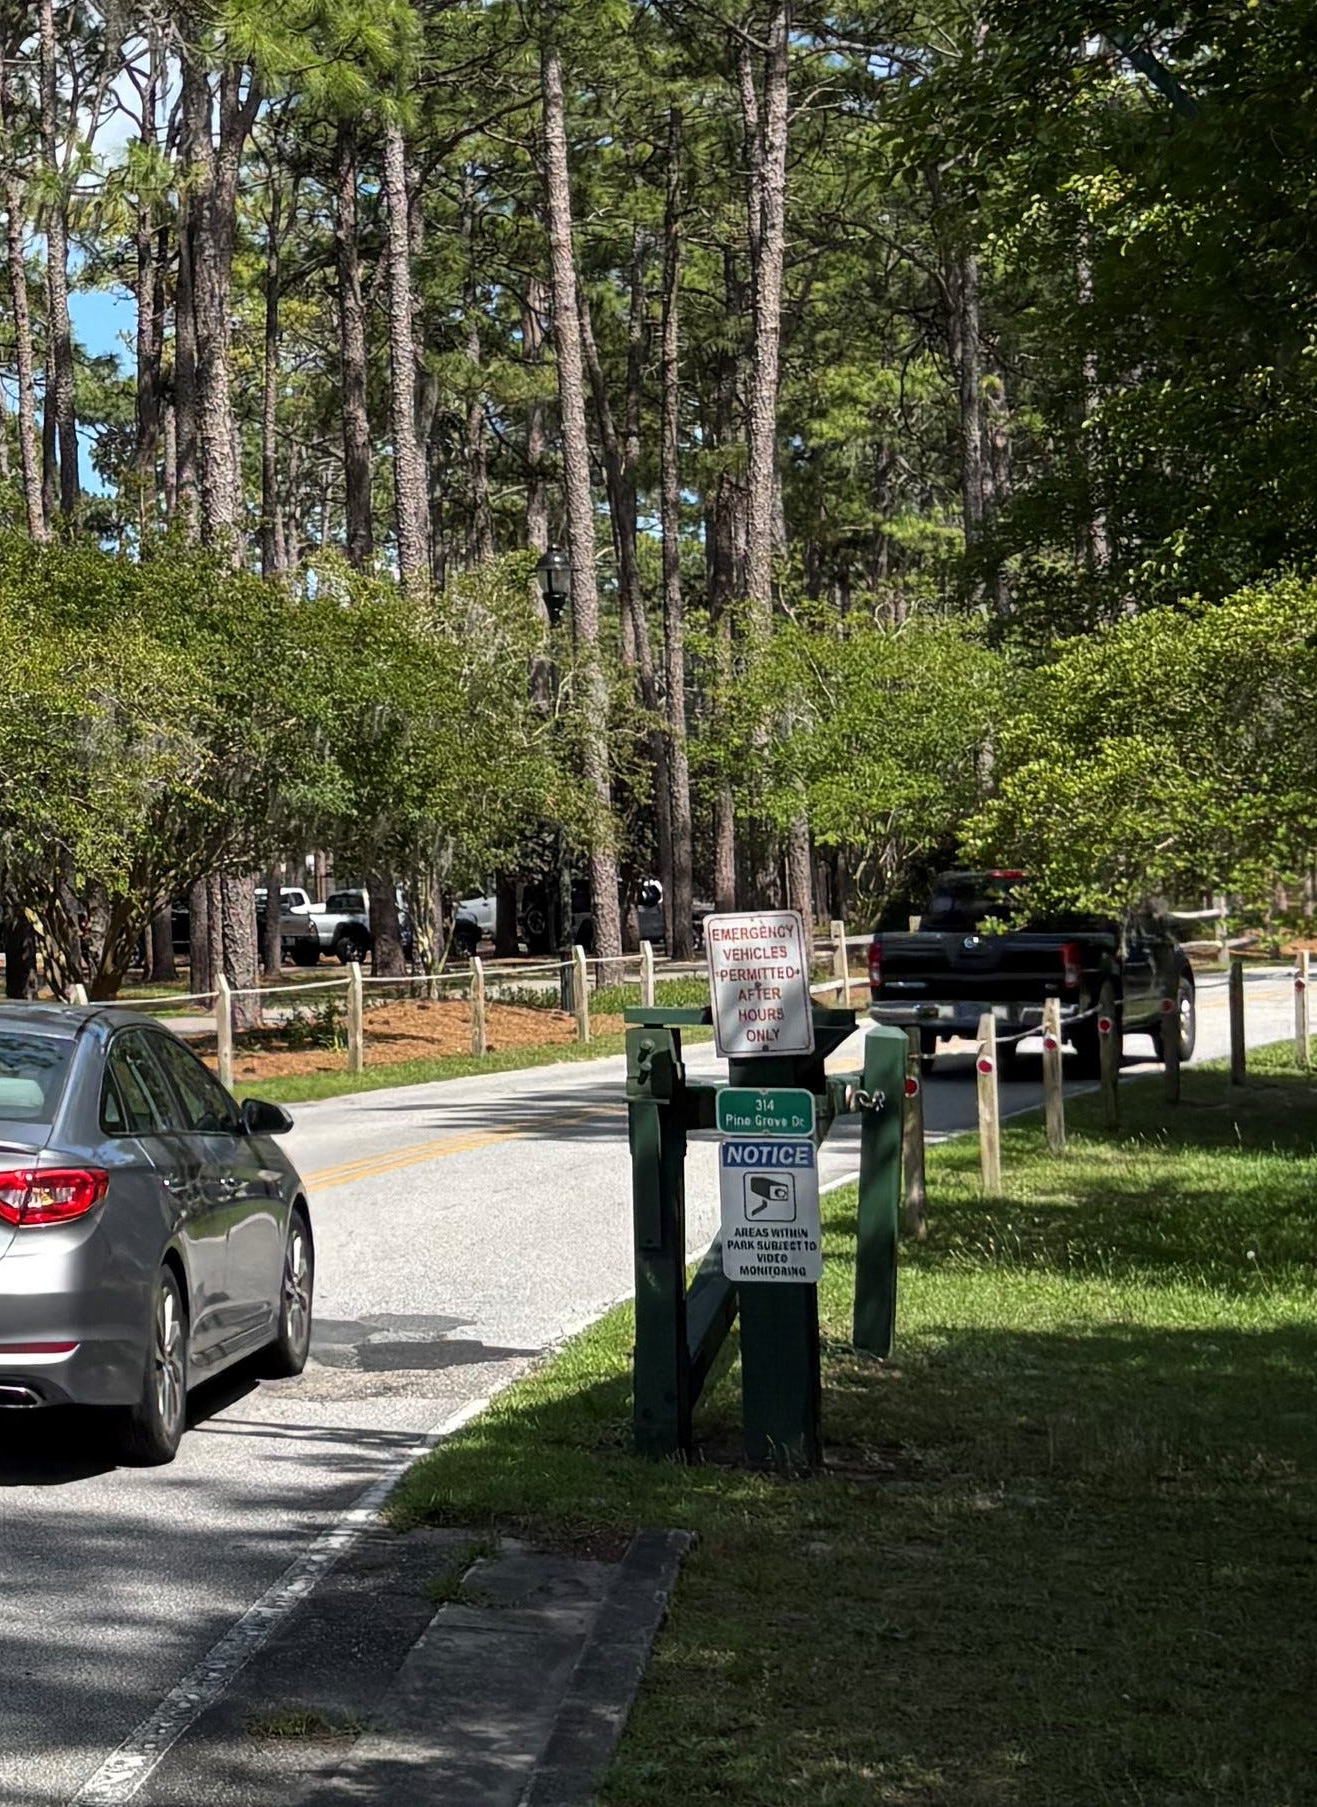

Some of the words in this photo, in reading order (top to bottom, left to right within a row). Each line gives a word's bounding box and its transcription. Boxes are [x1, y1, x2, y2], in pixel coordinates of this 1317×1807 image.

[712, 925, 794, 941] EMERGENCY
[723, 946, 787, 961] VEHICLES
[720, 966, 795, 981] PERMITTED
[738, 987, 781, 1001] AFTER
[739, 1008, 784, 1022] HOURS
[746, 1028, 780, 1042] ONLY
[755, 1099, 774, 1111] 314
[726, 1113, 751, 1126] Pine
[755, 1114, 787, 1127] Grove
[727, 1146, 809, 1164] NOTICE
[734, 1228, 769, 1237] AREAS
[771, 1228, 808, 1238] WITHIN
[727, 1240, 755, 1250] PARK
[757, 1241, 801, 1251] SUBJECT
[802, 1241, 817, 1251] TO
[757, 1253, 788, 1263] VIDEO
[740, 1265, 806, 1276] MONITORING
